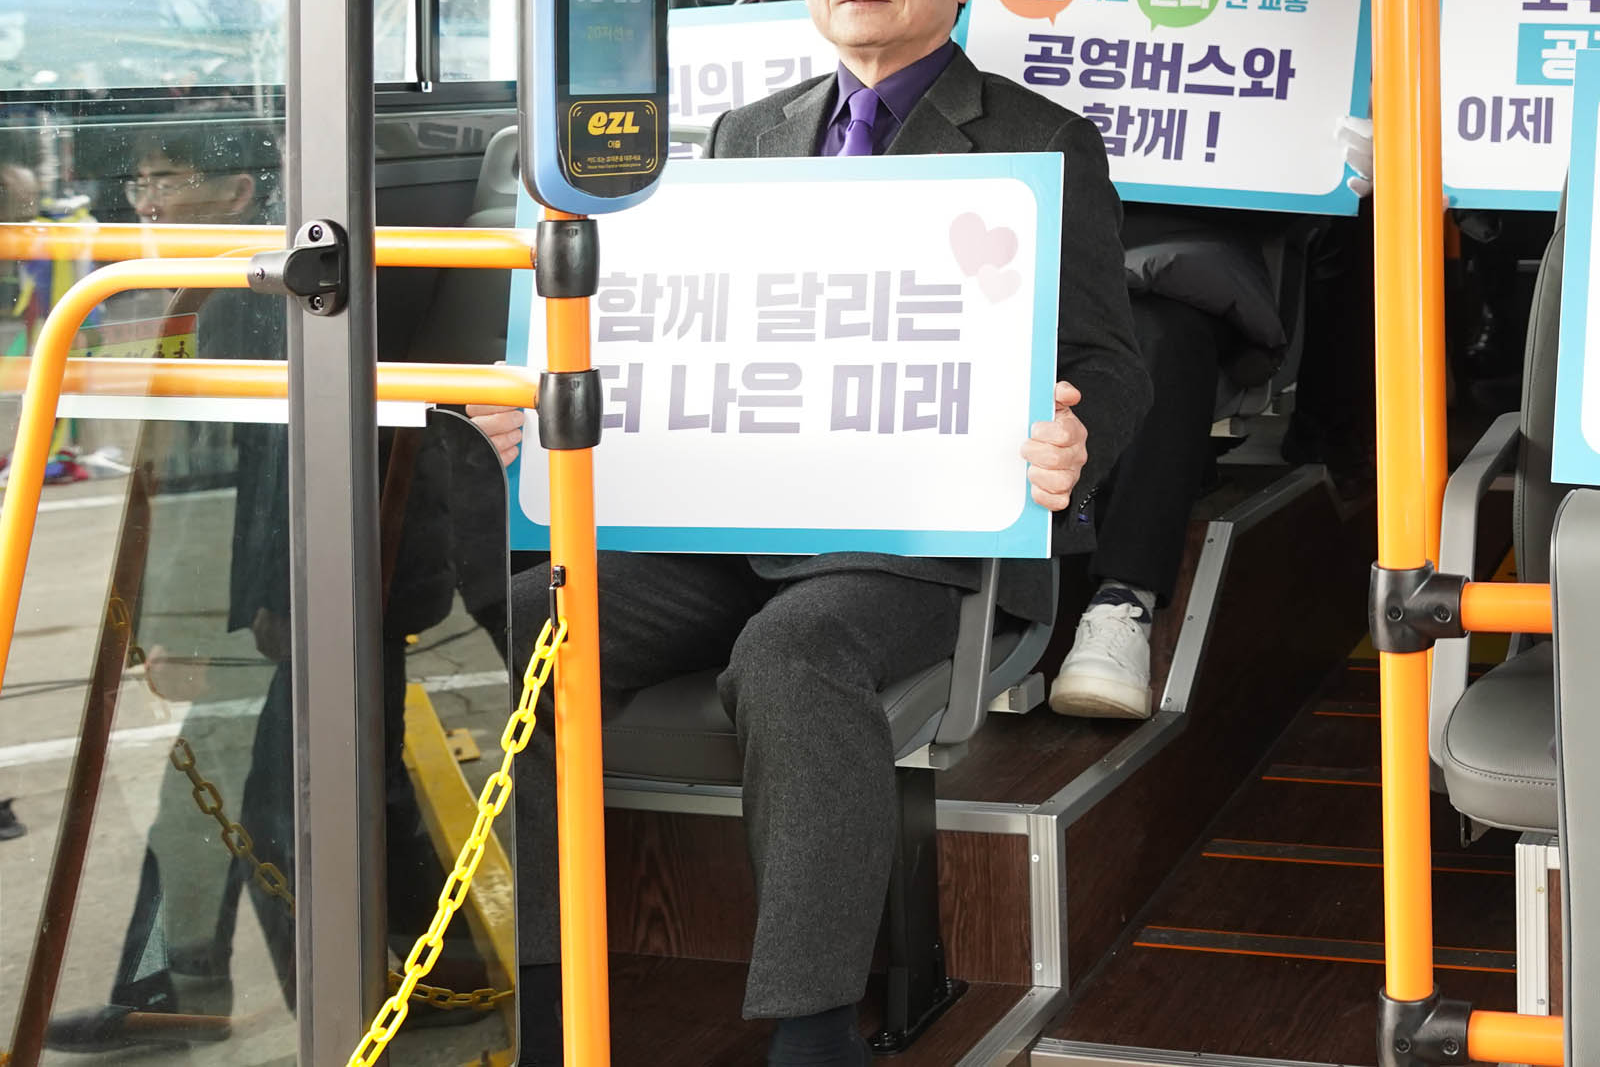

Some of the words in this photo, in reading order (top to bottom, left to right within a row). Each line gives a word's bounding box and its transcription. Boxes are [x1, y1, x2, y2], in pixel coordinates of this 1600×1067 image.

[1023, 33, 1297, 101] 공영버스와
[1082, 102, 1188, 162] 함께
[1204, 110, 1221, 163] !
[1457, 96, 1555, 144] 이제
[597, 272, 730, 342] 함께
[756, 269, 964, 342] 달리는
[668, 362, 803, 434] 나은
[830, 361, 972, 435] 미래
